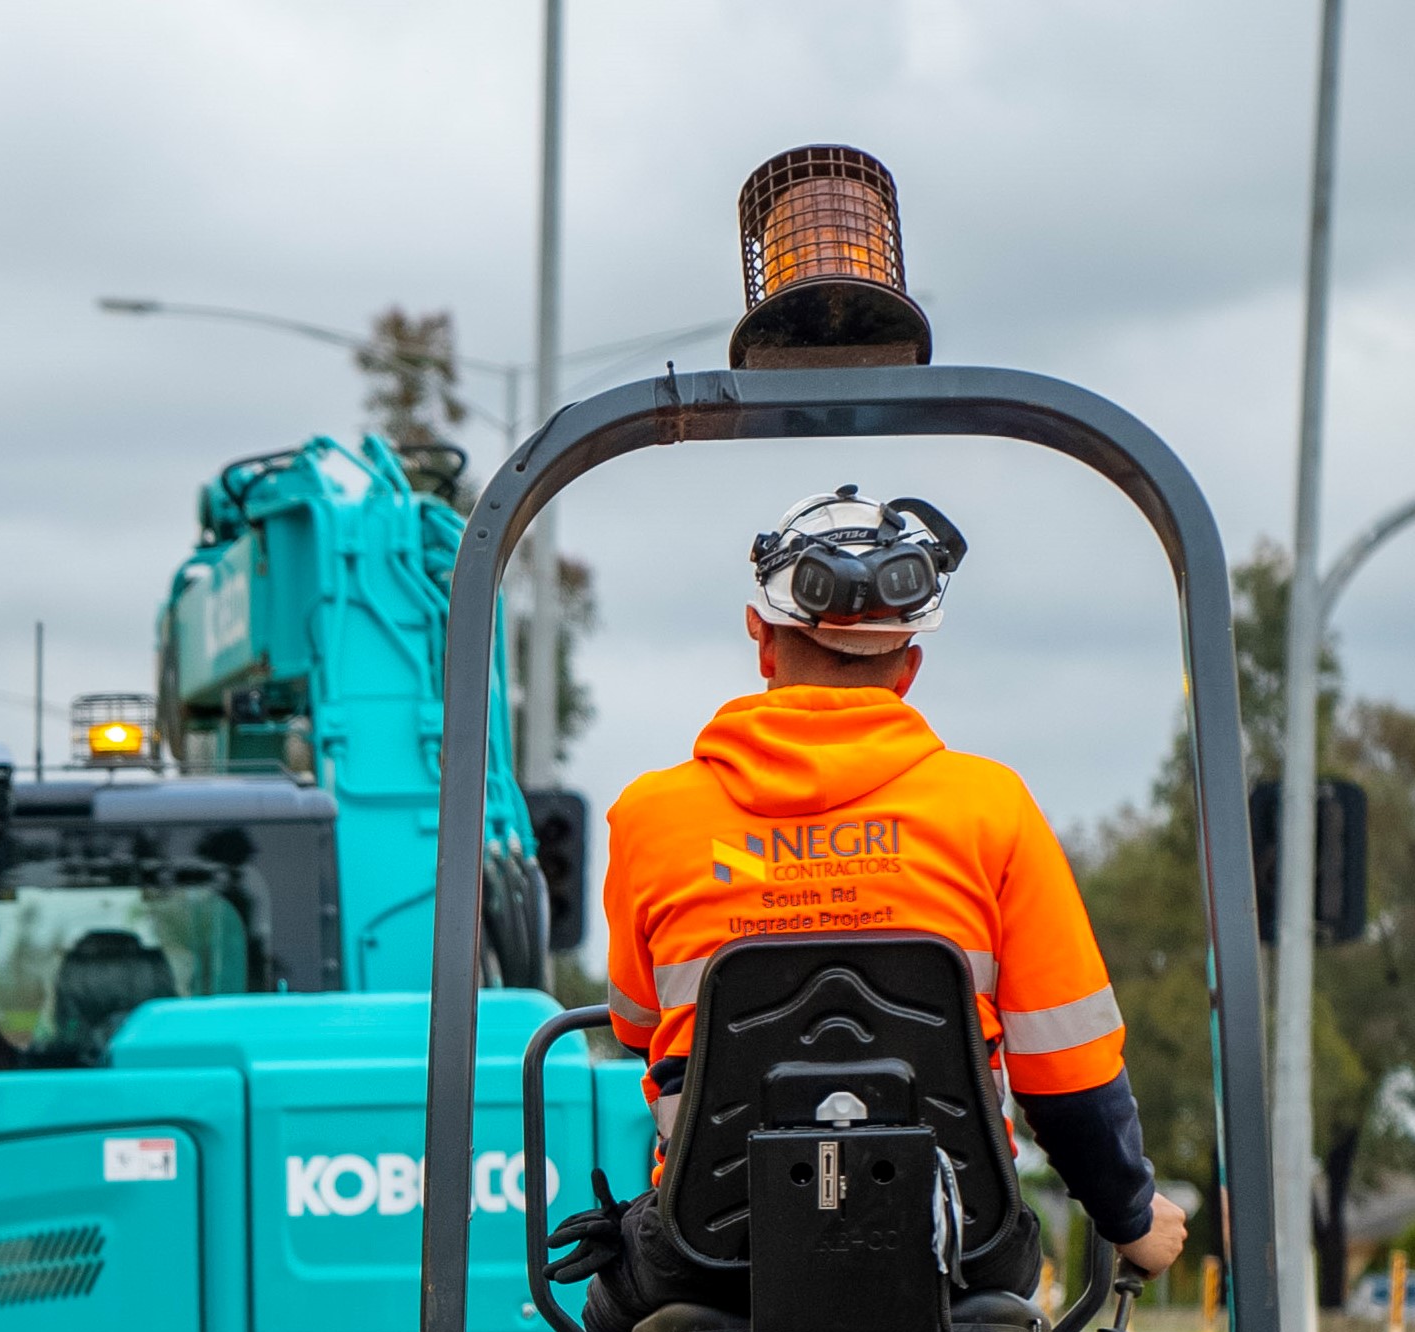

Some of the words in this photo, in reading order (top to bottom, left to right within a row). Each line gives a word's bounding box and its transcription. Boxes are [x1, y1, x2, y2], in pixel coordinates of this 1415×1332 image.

[772, 819, 899, 862] NEGRI
[774, 858, 902, 881] CONTRACTORS
[762, 890, 821, 908] South
[832, 886, 857, 903] Rd
[729, 914, 813, 936] Upgrade
[819, 906, 893, 928] Project
[286, 1150, 560, 1217] KOBCO
